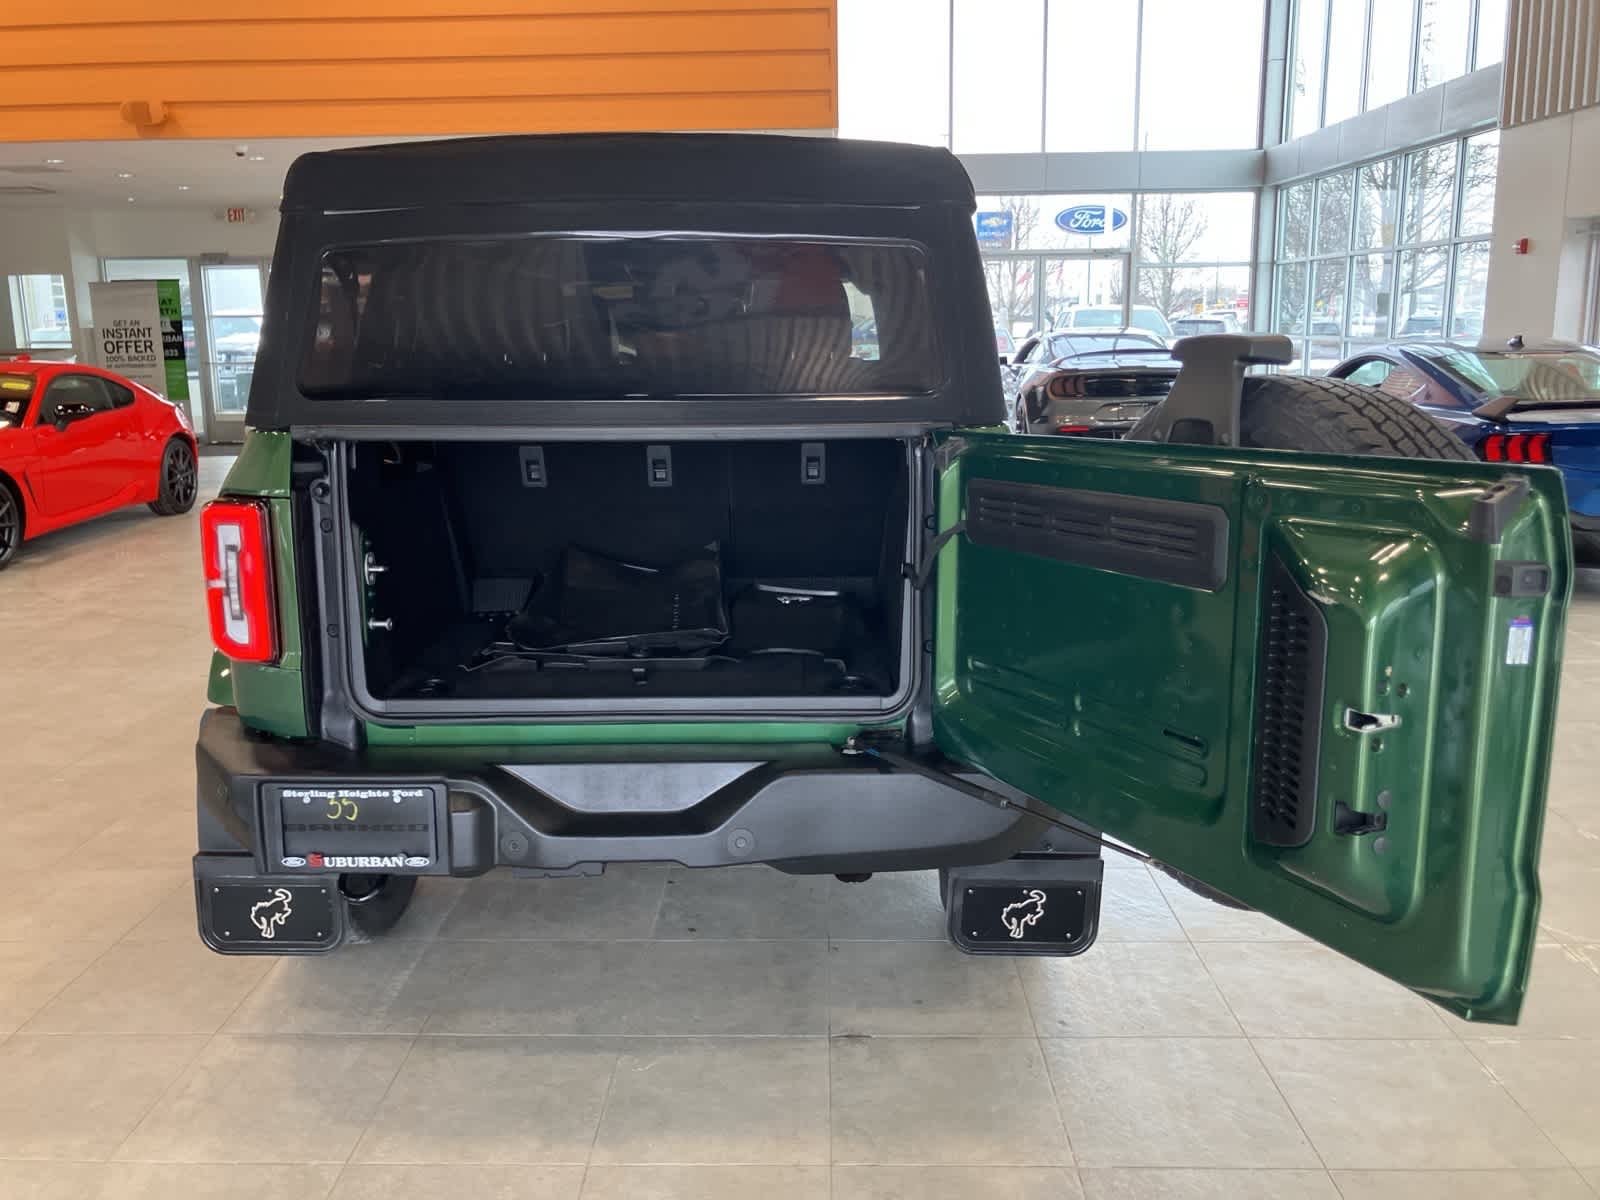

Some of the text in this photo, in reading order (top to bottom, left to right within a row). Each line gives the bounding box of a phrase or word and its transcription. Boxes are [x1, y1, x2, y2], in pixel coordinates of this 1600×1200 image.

[227, 208, 246, 223] EXIT
[102, 327, 153, 339] INSTANT
[104, 340, 154, 354] OFFER
[338, 789, 390, 798] Heights
[393, 789, 424, 798] Ford
[307, 852, 404, 868] SUBURBAN
